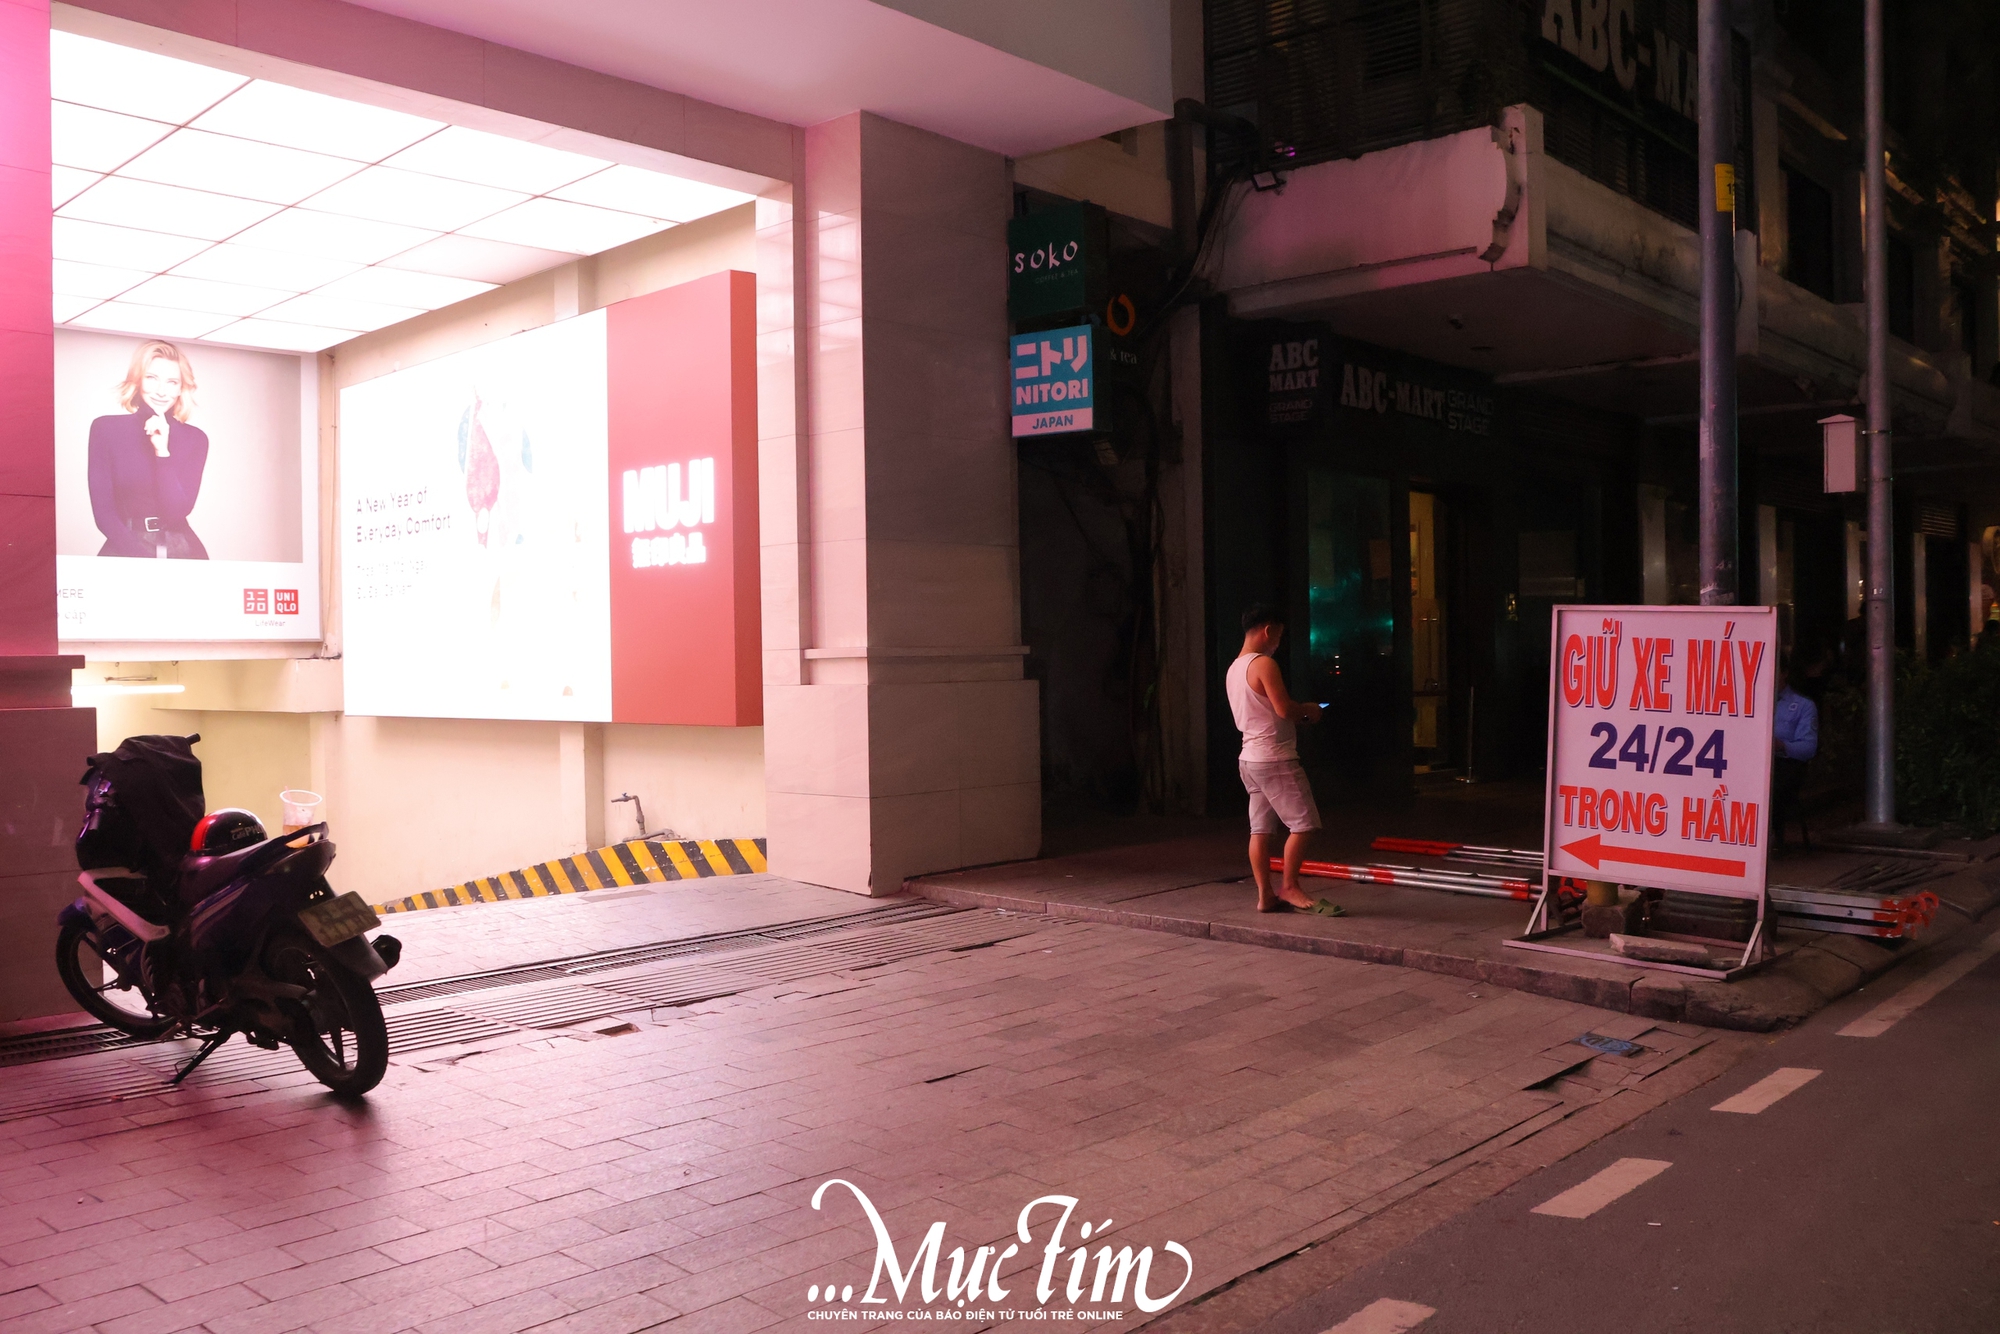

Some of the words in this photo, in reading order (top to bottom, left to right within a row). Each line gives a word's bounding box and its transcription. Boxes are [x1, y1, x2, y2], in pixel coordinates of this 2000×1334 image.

[1015, 240, 1079, 274] soko
[1015, 334, 1088, 380] ニトリ
[1120, 350, 1138, 364] tea
[1268, 339, 1320, 372] ABC
[1015, 378, 1089, 406] NITORI
[1269, 368, 1320, 393] MART
[1340, 363, 1446, 421] ABC-MART
[1032, 414, 1074, 430] JAPAN
[356, 498, 363, 515] A
[365, 496, 386, 513] New
[389, 491, 413, 509] Year
[416, 485, 428, 505] of
[623, 457, 714, 534] MUJI
[356, 523, 402, 544] Everyday
[405, 513, 451, 535] Comfort
[1562, 617, 1622, 709] GIỮ
[1629, 637, 1674, 713] XE
[1685, 620, 1765, 718] MÁY
[1588, 721, 1728, 779] 24/24
[1558, 784, 1668, 836] TRONG
[1680, 784, 1760, 847] HẦM
